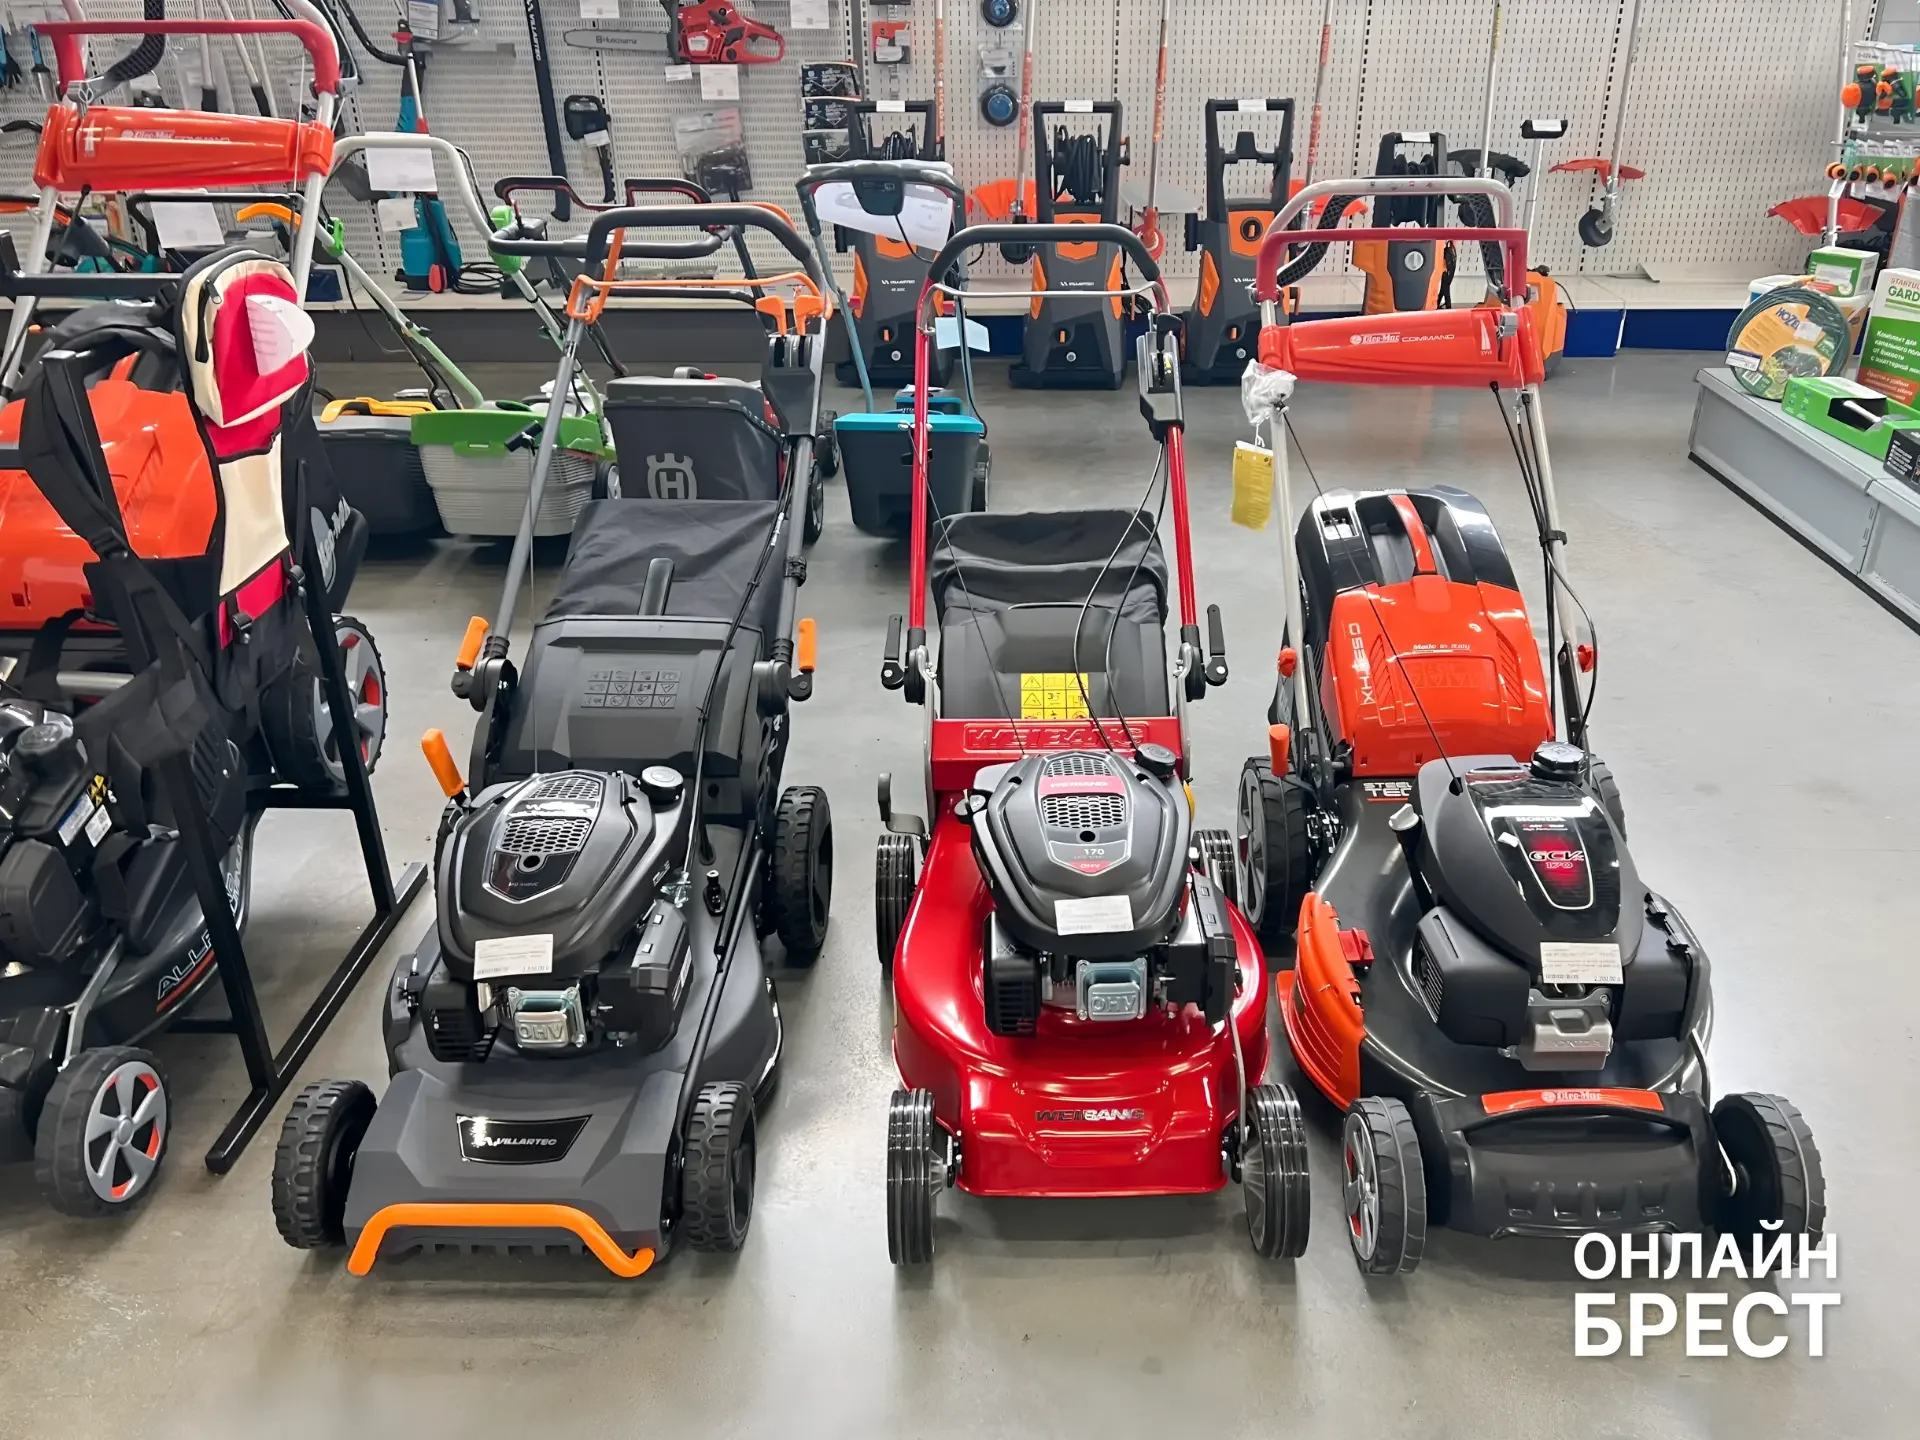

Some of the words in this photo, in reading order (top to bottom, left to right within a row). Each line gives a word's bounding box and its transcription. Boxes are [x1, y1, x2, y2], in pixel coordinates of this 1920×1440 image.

[603, 36, 637, 45] Husqvarna
[1888, 285, 1920, 302] GARD
[1776, 307, 1801, 330] HOZE
[1361, 333, 1400, 344] Oleo-Mac
[1401, 334, 1455, 343] COMMAND
[968, 728, 1145, 748] WEIBANG
[1091, 995, 1137, 1012] OHV
[517, 1023, 564, 1041] OHV
[1035, 1108, 1145, 1121] WEIBANG
[497, 1138, 557, 1146] VILLARTEC
